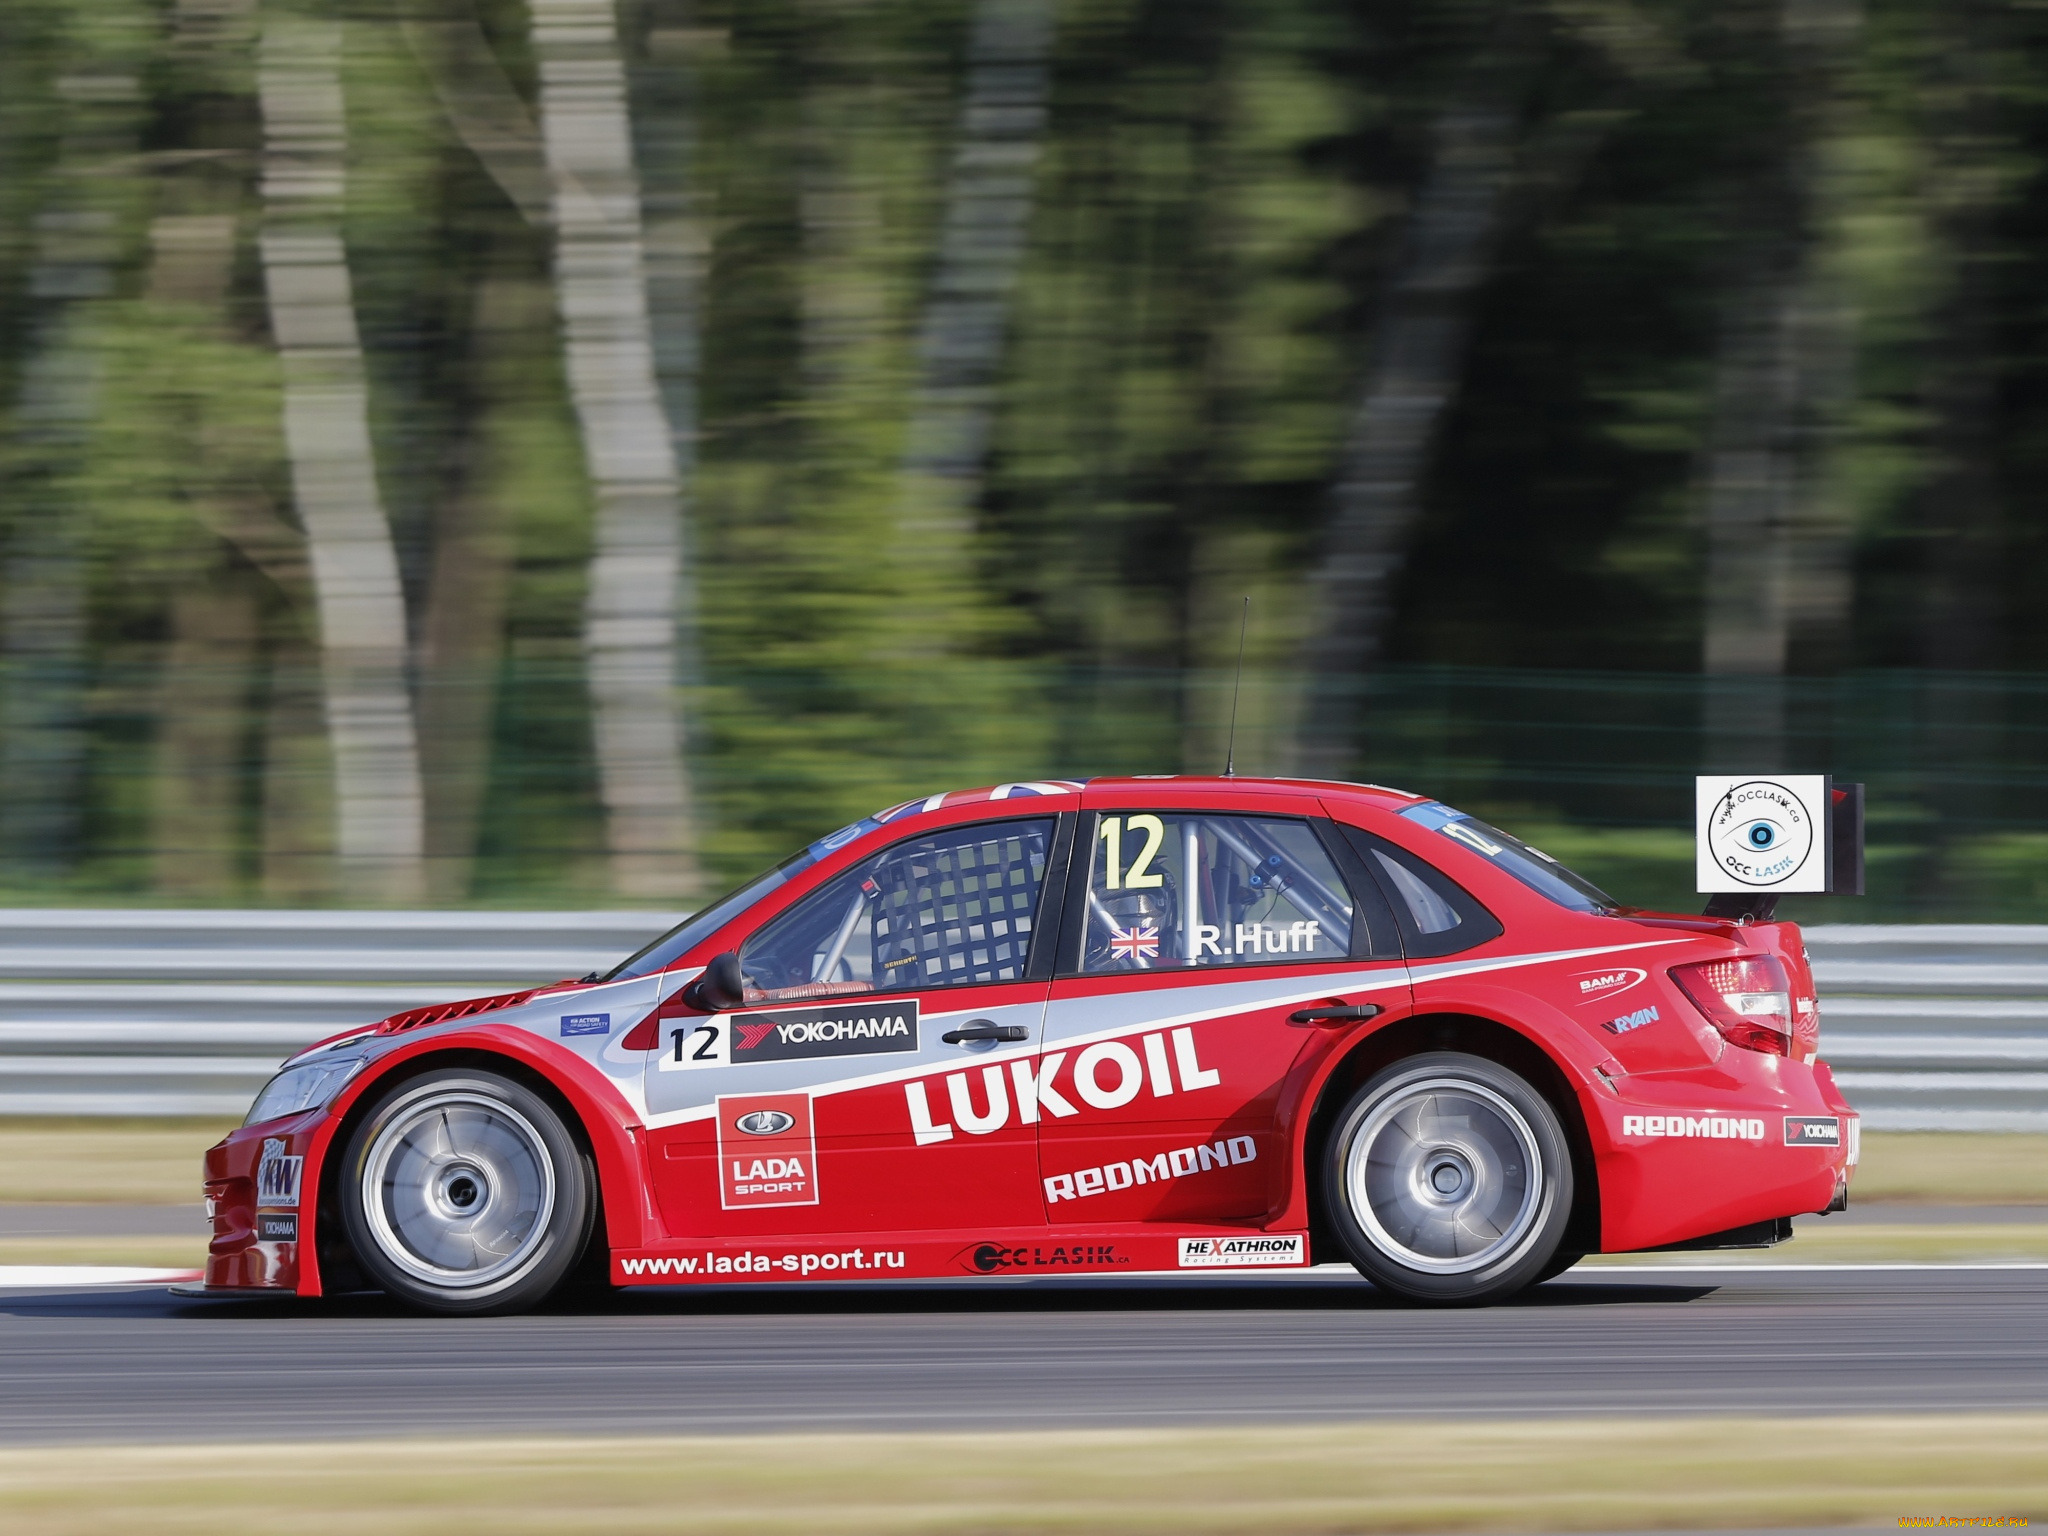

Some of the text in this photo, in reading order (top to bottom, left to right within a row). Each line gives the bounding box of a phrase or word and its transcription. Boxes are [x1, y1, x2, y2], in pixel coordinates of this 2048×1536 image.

[1100, 814, 1164, 890] 12
[1442, 823, 1502, 857] 12
[1726, 855, 1794, 877] OCC LASIK
[1194, 920, 1320, 957] R.Huff
[1580, 975, 1615, 990] BAM
[776, 1016, 909, 1044] YOKOHAMA
[1614, 1005, 1660, 1034] RYAN
[669, 1026, 720, 1062] 12
[904, 1026, 1221, 1146] LUKOIL
[1803, 1124, 1838, 1138] YOKOHAMA
[263, 1159, 300, 1196] KW
[733, 1157, 805, 1181] LADA
[735, 1181, 806, 1195] SPORT
[265, 1221, 294, 1235] YOKOHAMA
[1186, 1238, 1297, 1256] HEXATHRON
[1239, 1255, 1294, 1264] Systems
[621, 1248, 905, 1276] www.lada-sport.ru
